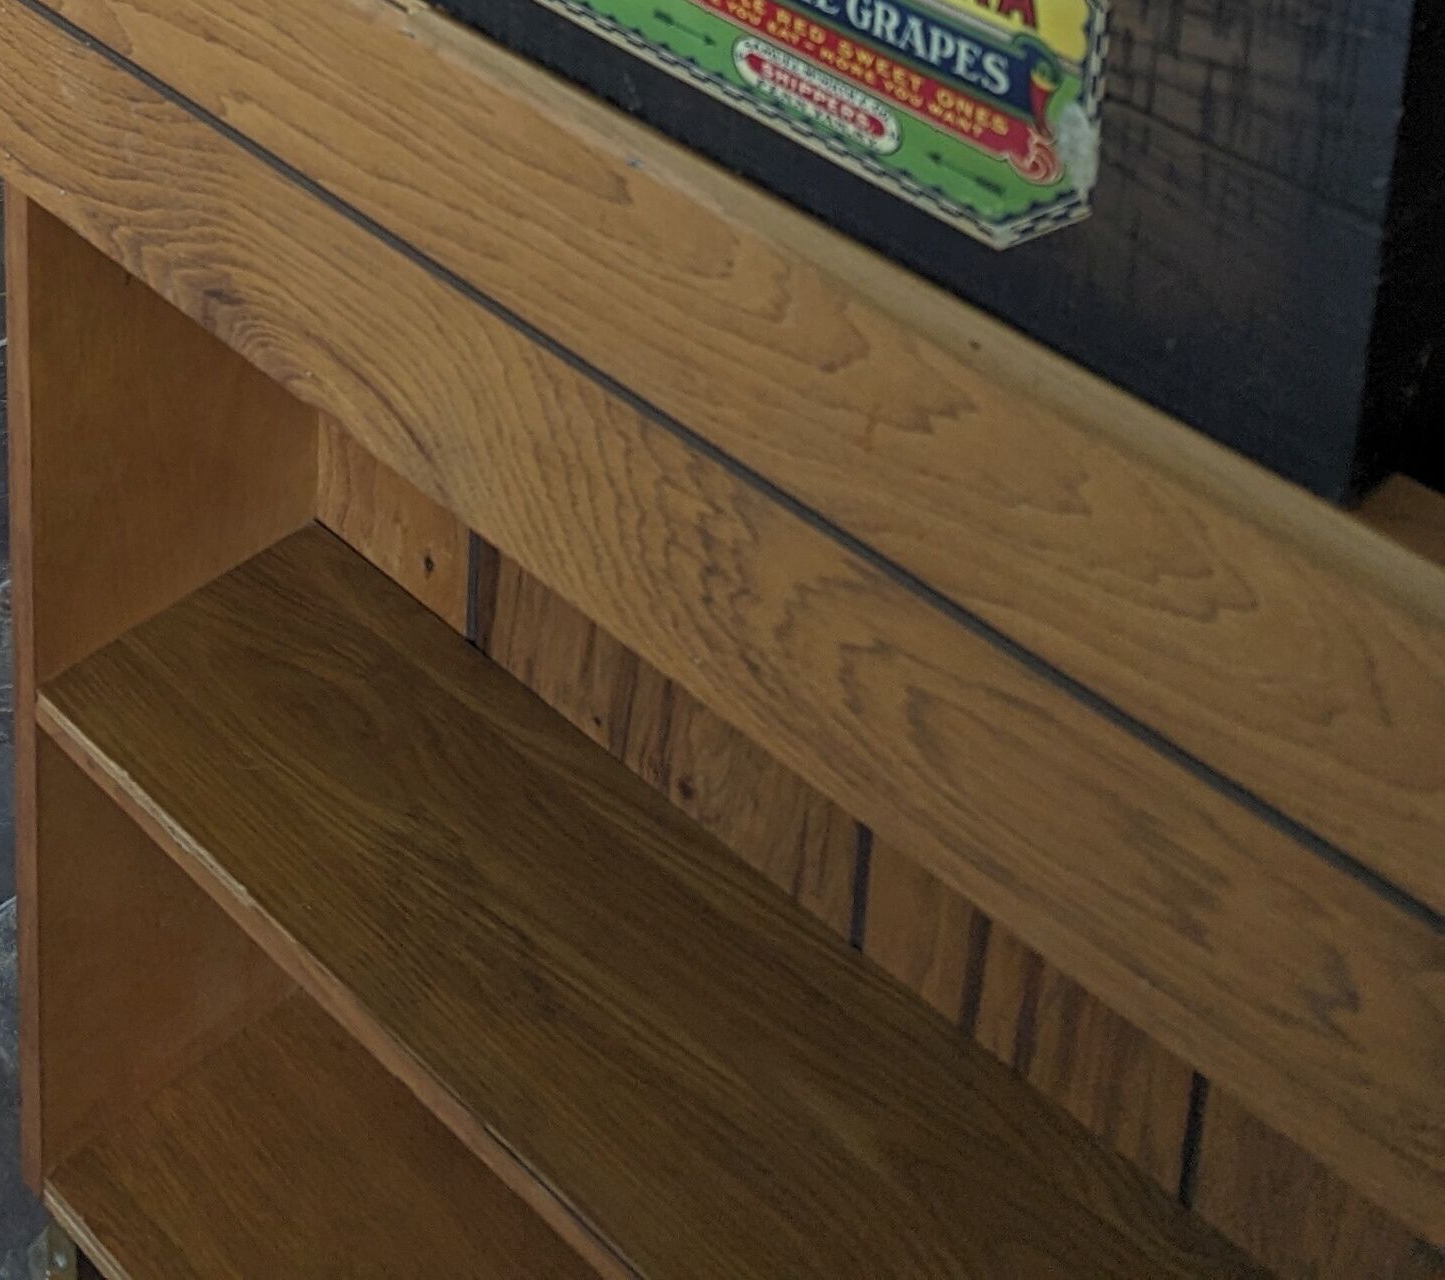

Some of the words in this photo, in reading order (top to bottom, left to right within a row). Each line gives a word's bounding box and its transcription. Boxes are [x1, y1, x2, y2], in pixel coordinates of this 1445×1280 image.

[726, 0, 762, 27] YOU
[819, 46, 877, 86] MORE
[883, 78, 926, 109] YOU
[926, 101, 984, 138] WANT
[776, 7, 827, 45] RED
[837, 39, 923, 92] SWEET
[936, 86, 1010, 137] ONES
